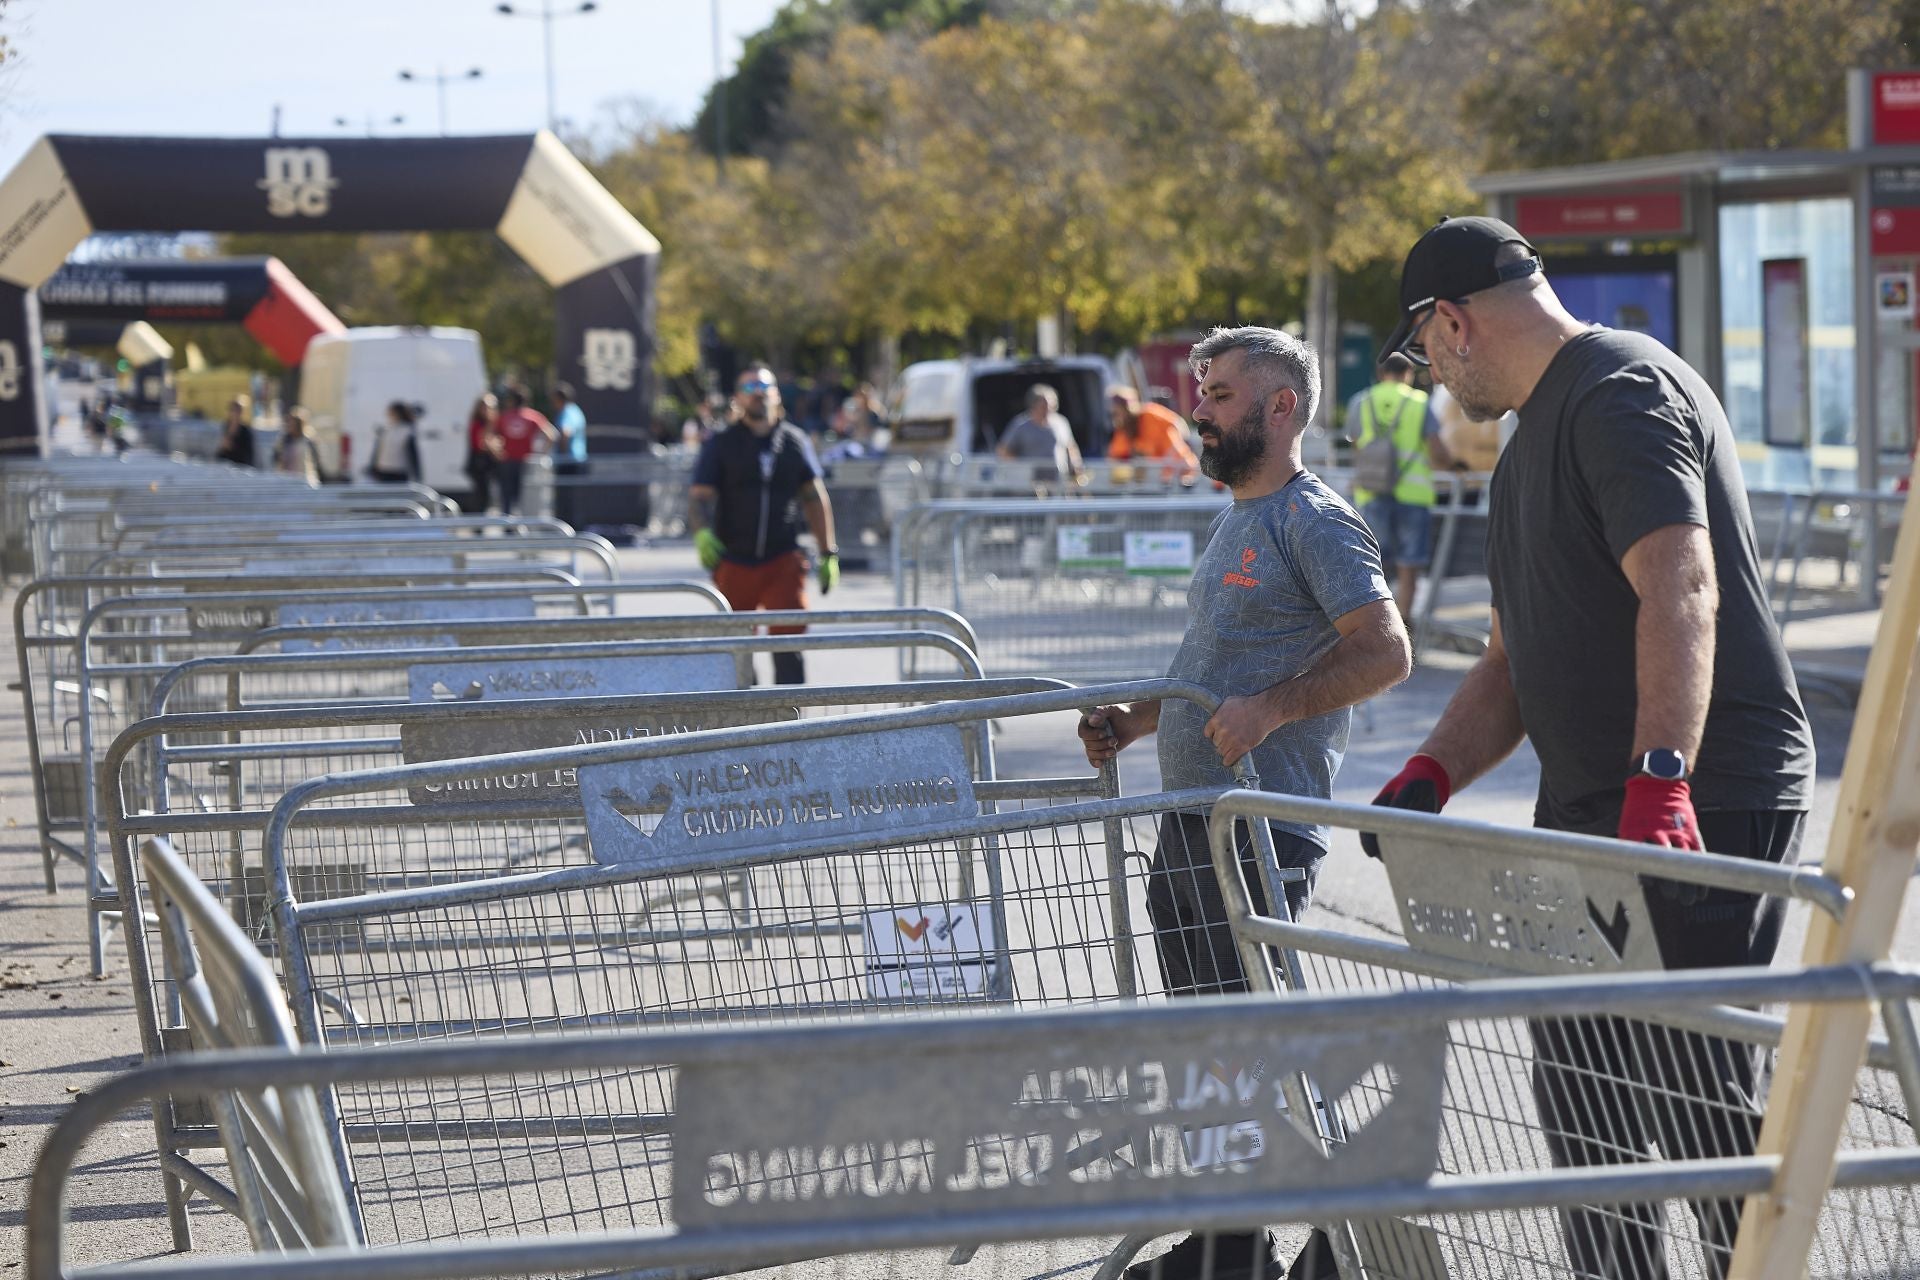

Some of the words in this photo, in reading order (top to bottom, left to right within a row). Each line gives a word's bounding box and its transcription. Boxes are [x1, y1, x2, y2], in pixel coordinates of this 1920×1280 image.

[674, 757, 806, 798] VALENCIA
[683, 800, 784, 838] CIUDAD
[791, 789, 844, 825] DEL
[847, 775, 958, 818] RUNNING
